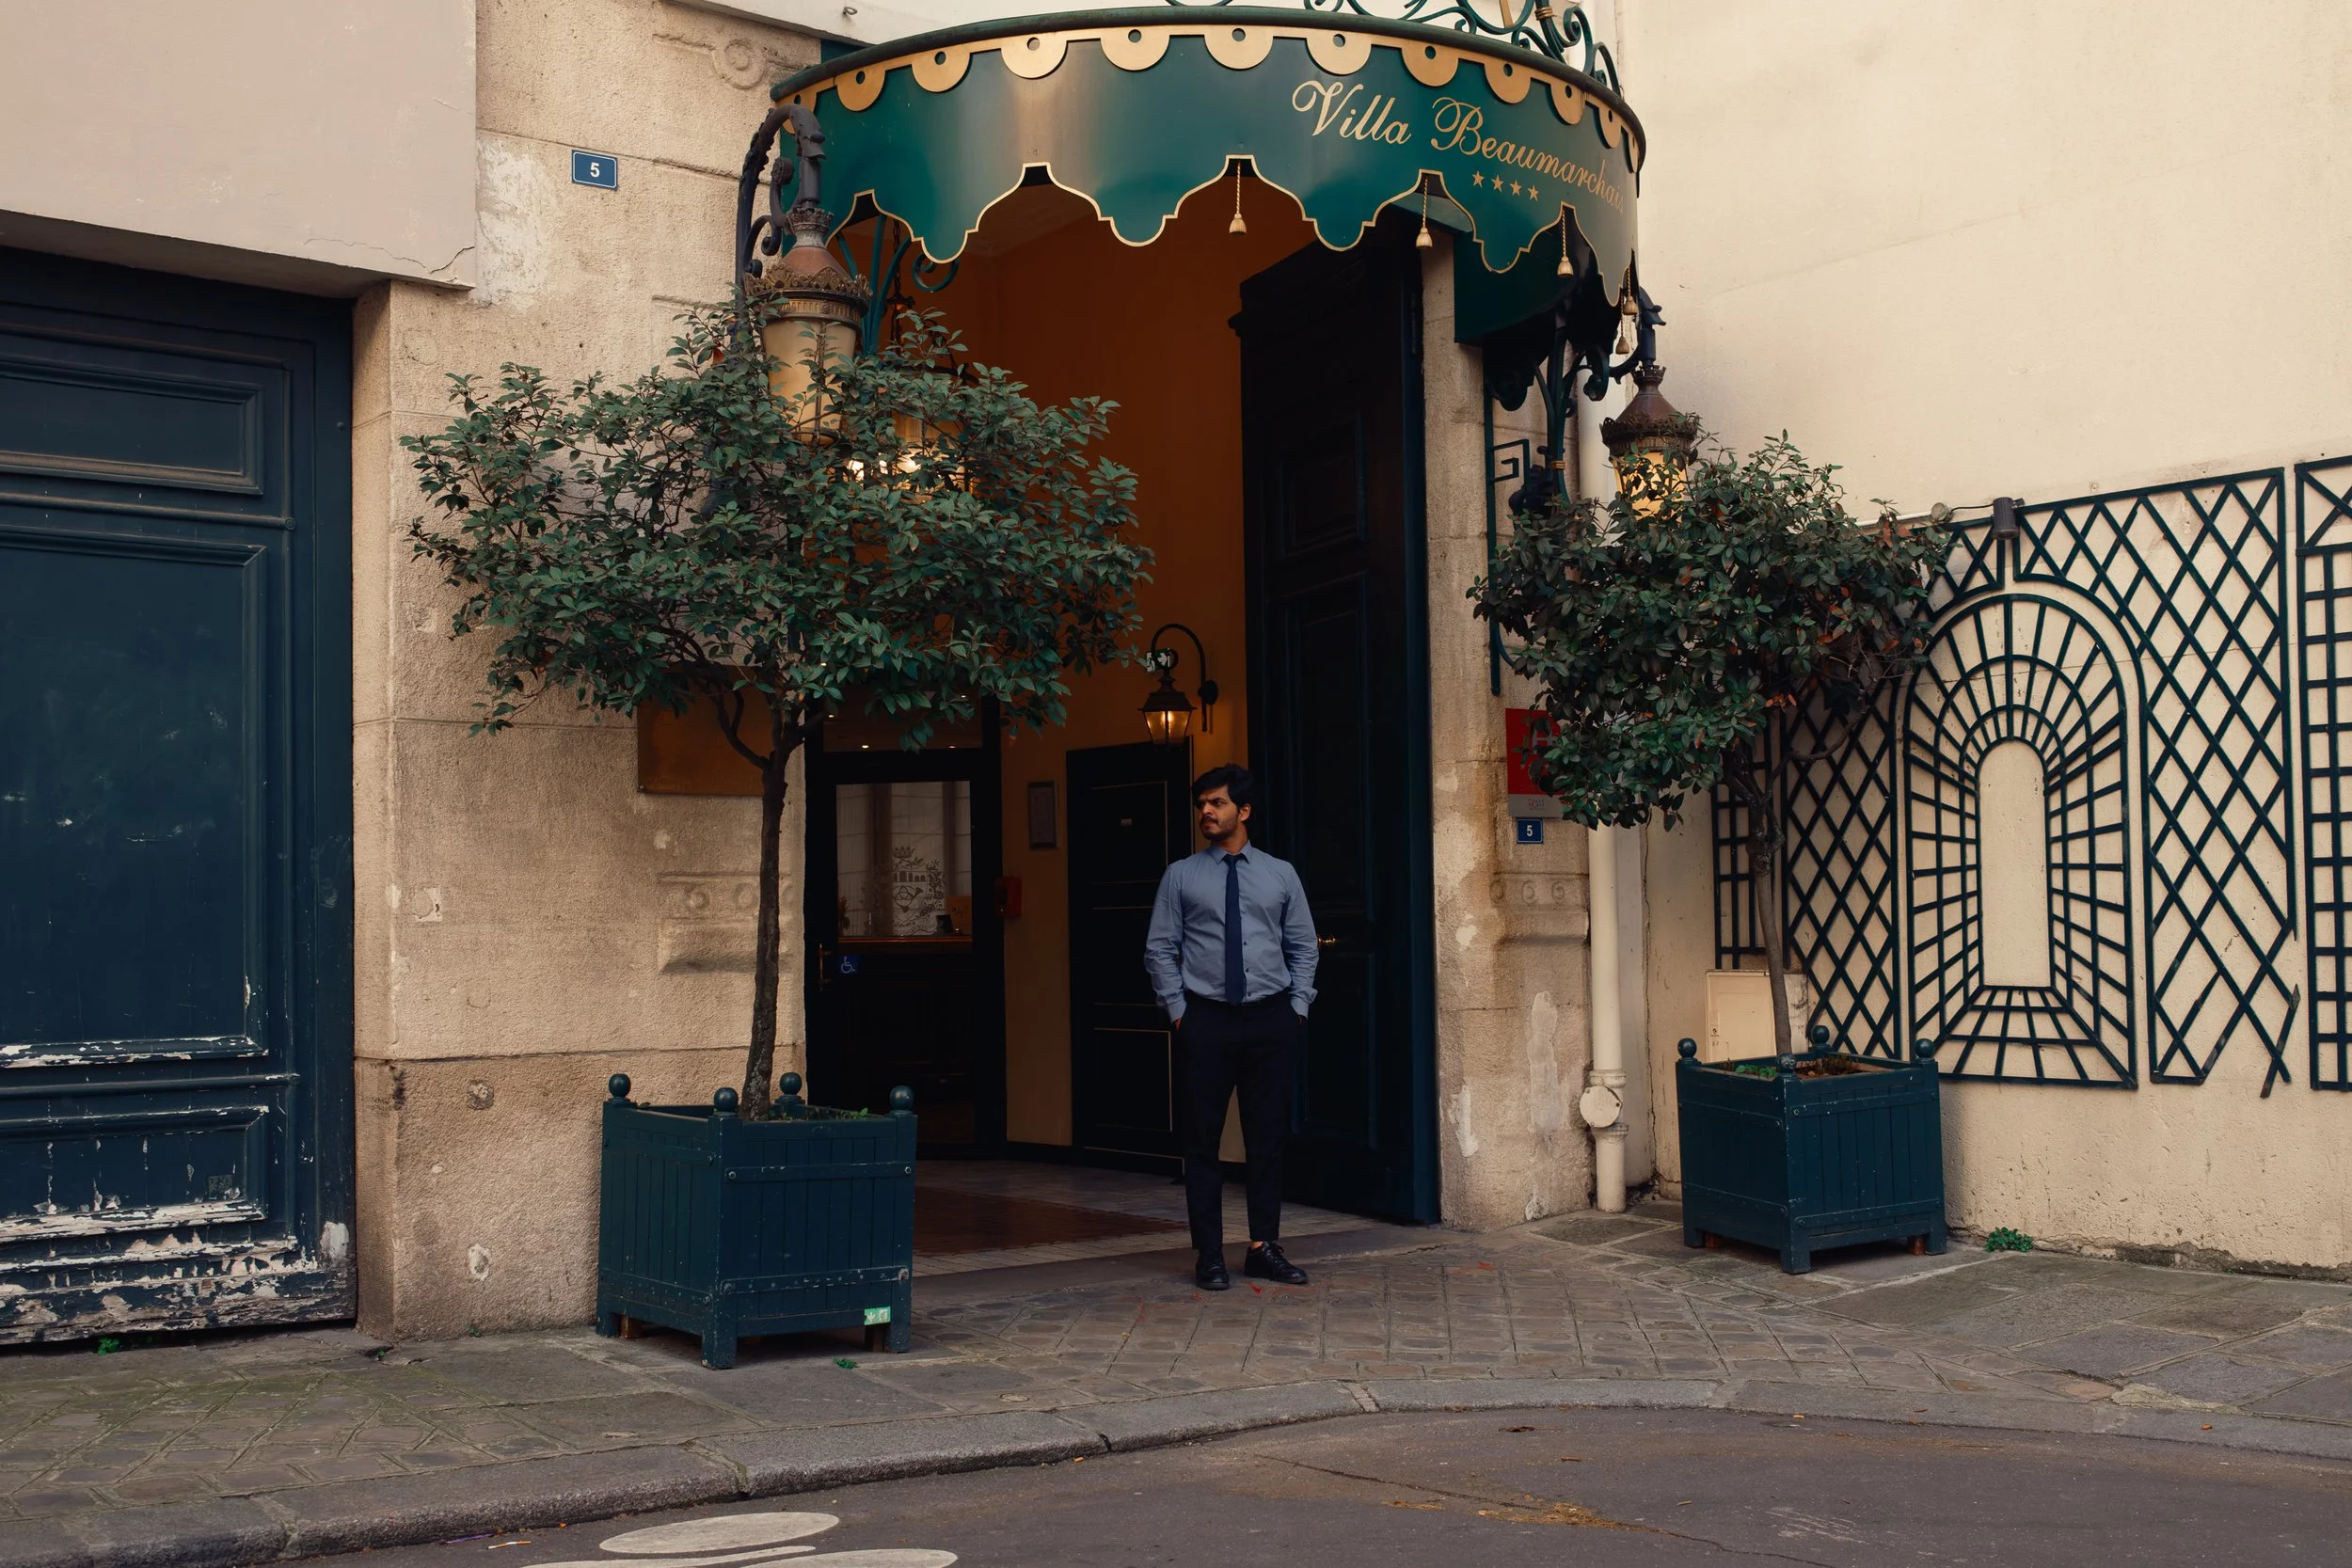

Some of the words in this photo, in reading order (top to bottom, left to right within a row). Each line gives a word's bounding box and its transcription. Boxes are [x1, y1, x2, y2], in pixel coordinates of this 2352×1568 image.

[1292, 80, 1411, 145] Villa
[1431, 97, 1626, 214] Beaumarchais
[590, 162, 600, 178] 5
[1526, 824, 1534, 837] 5
